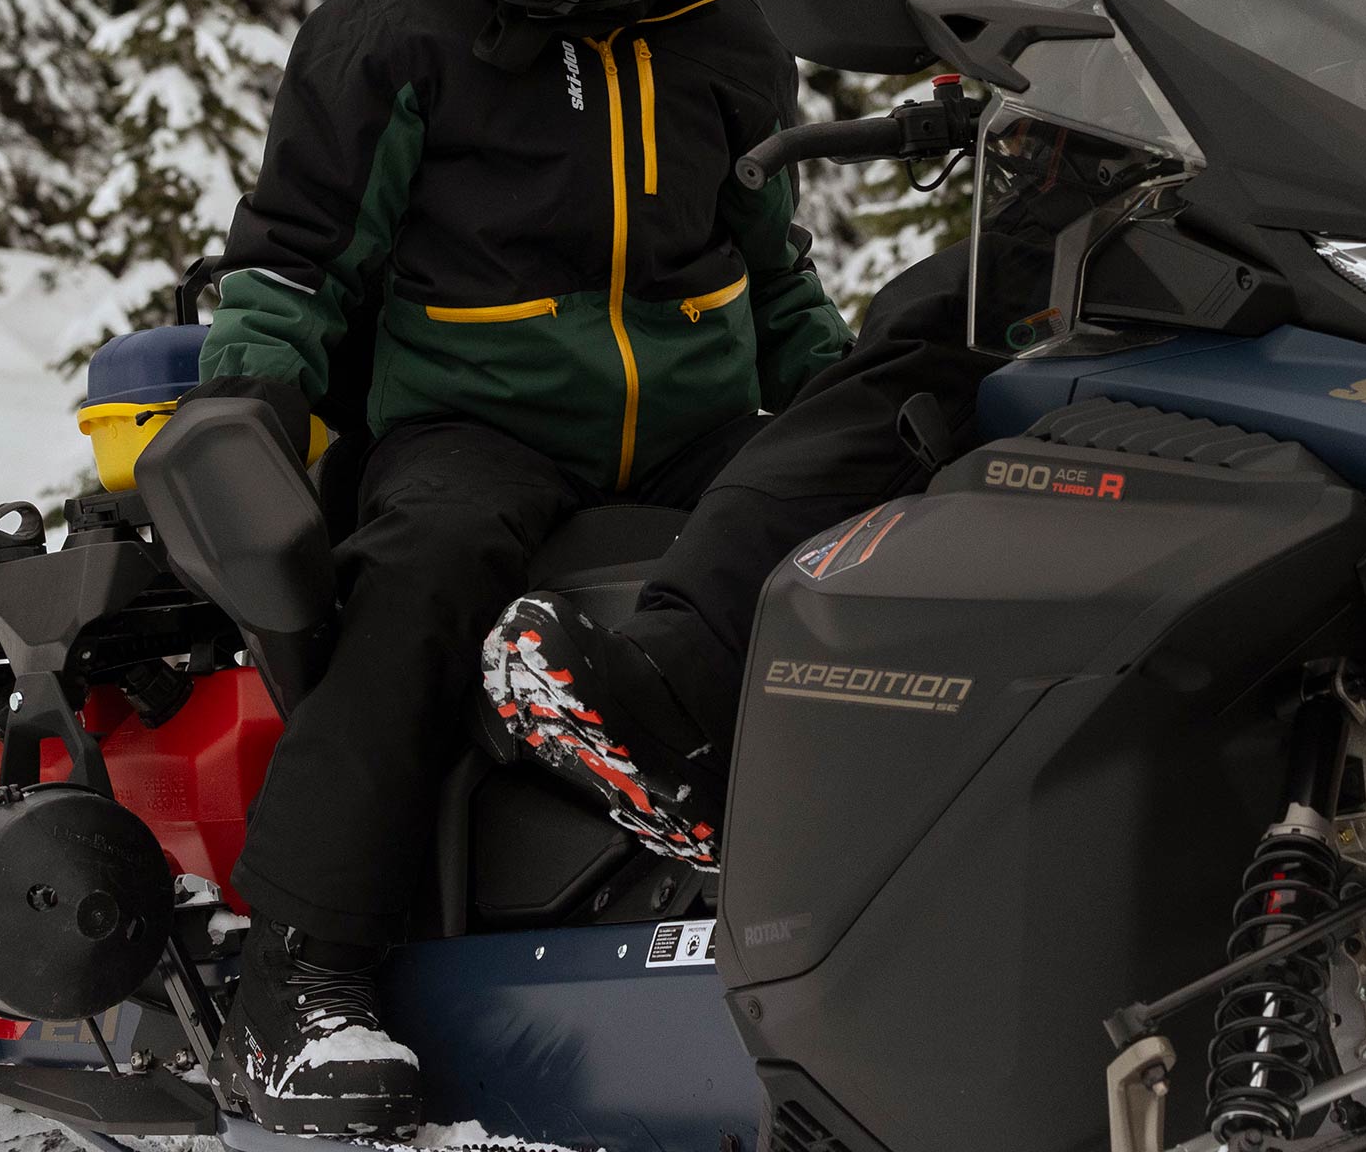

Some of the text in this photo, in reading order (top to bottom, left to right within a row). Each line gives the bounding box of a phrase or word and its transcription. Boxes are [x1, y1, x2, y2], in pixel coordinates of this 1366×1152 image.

[561, 40, 584, 111] ski-doo
[985, 460, 1087, 490] 900 ACE
[1051, 472, 1125, 500] TURBO R
[765, 660, 973, 701] EXPEDITION
[744, 921, 792, 947] ROTAX
